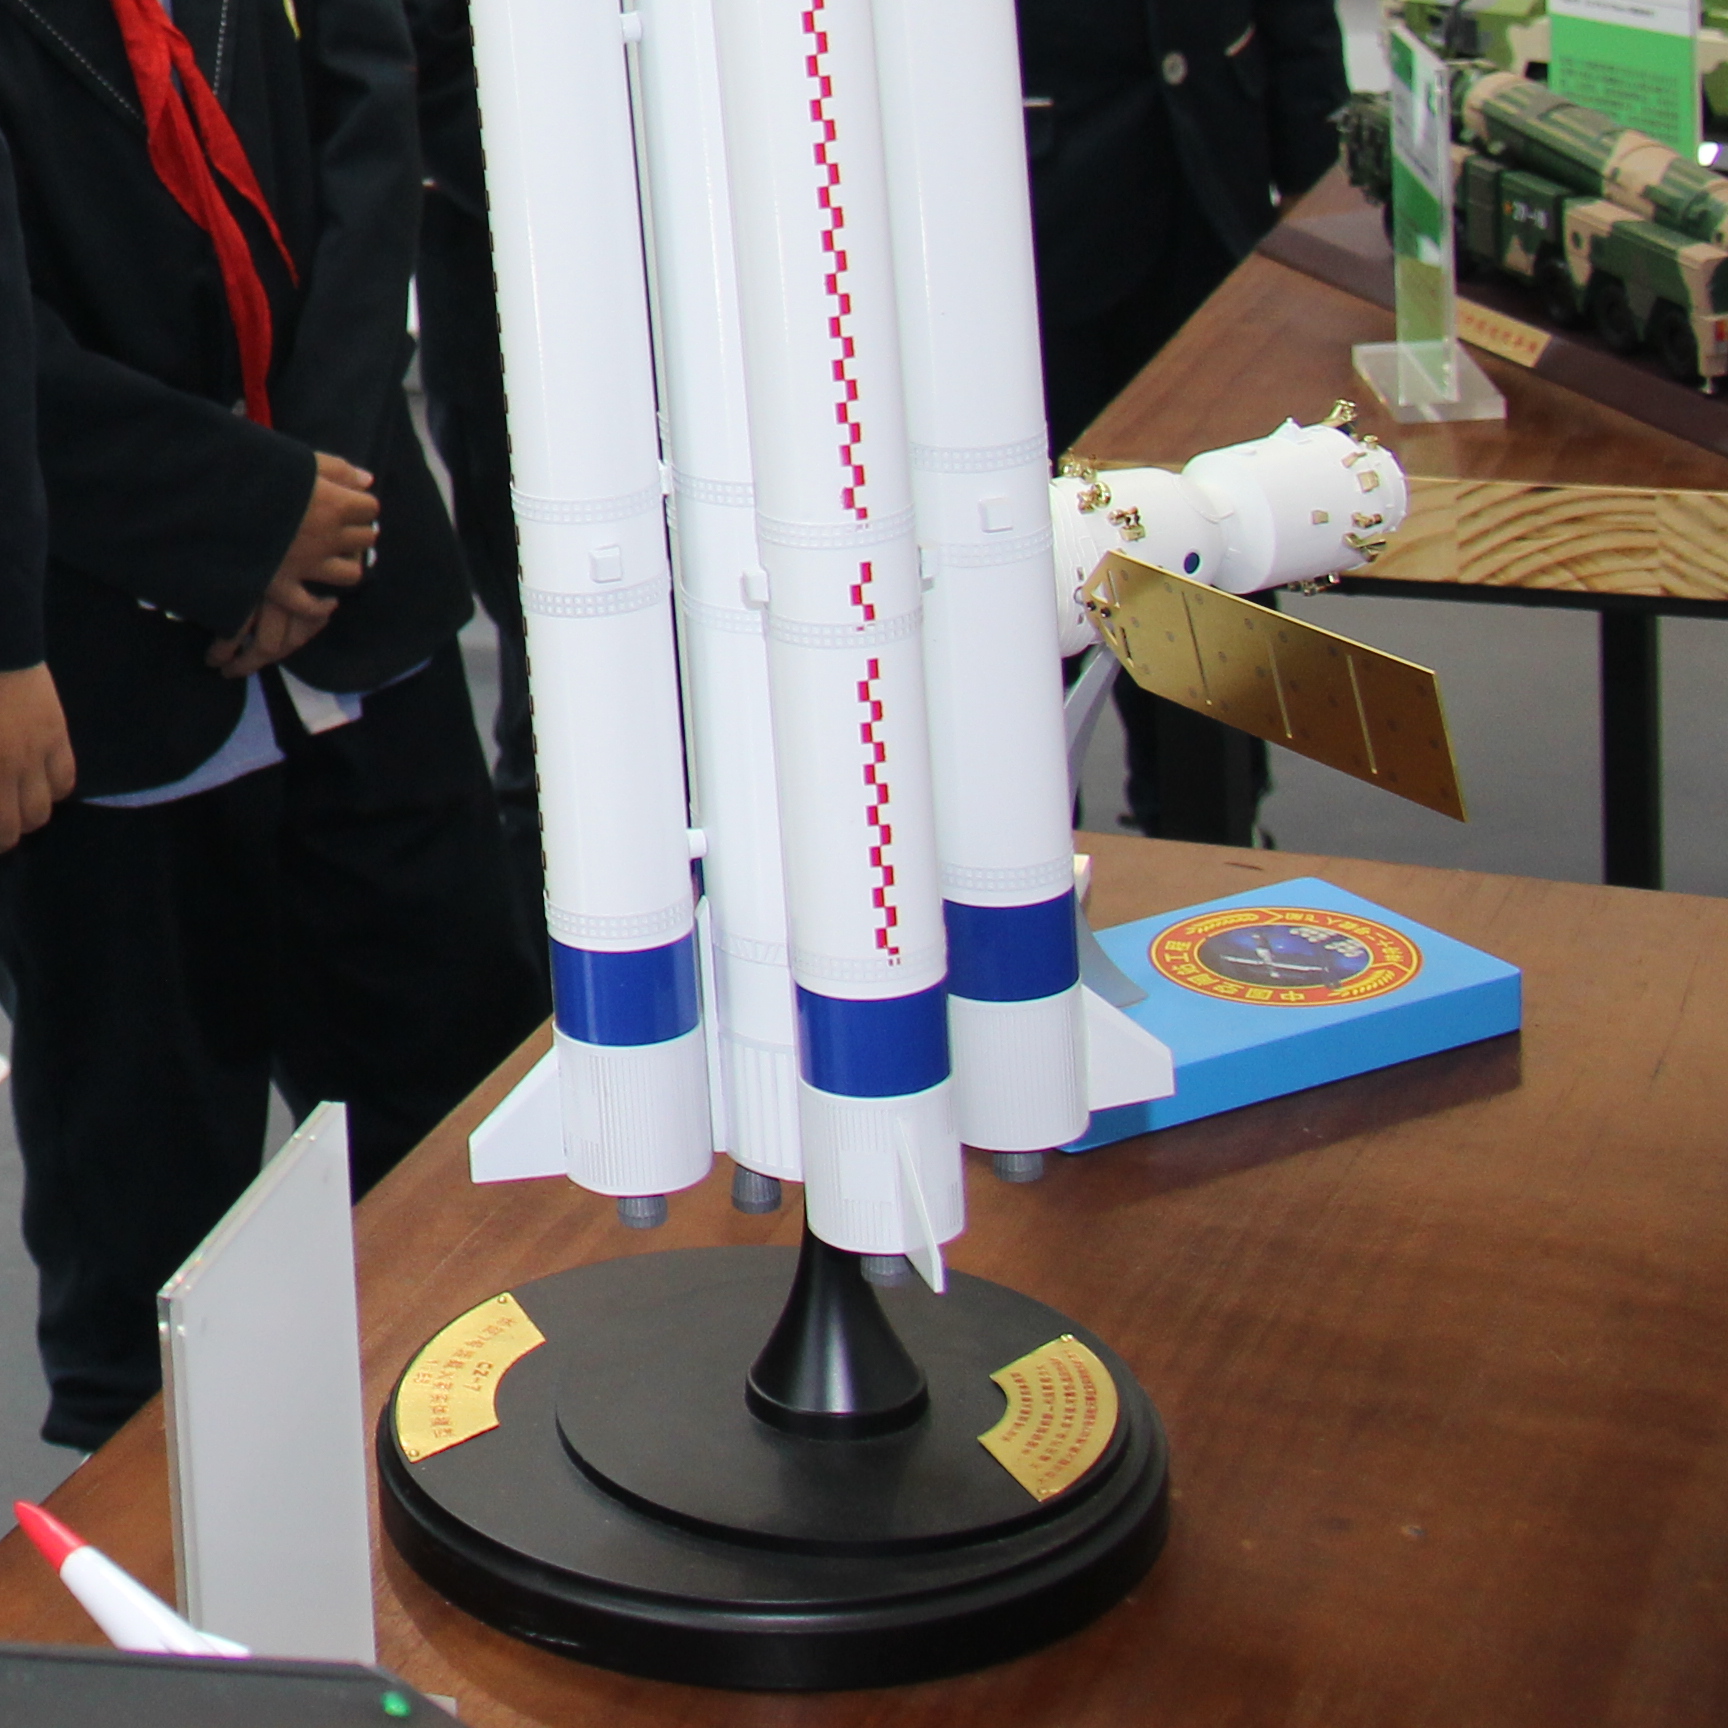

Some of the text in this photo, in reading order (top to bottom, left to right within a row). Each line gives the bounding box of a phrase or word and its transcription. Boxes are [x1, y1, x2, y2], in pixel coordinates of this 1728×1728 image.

[1162, 939, 1307, 1002] 中国空间站工程
[462, 1360, 494, 1393] CZ-7
